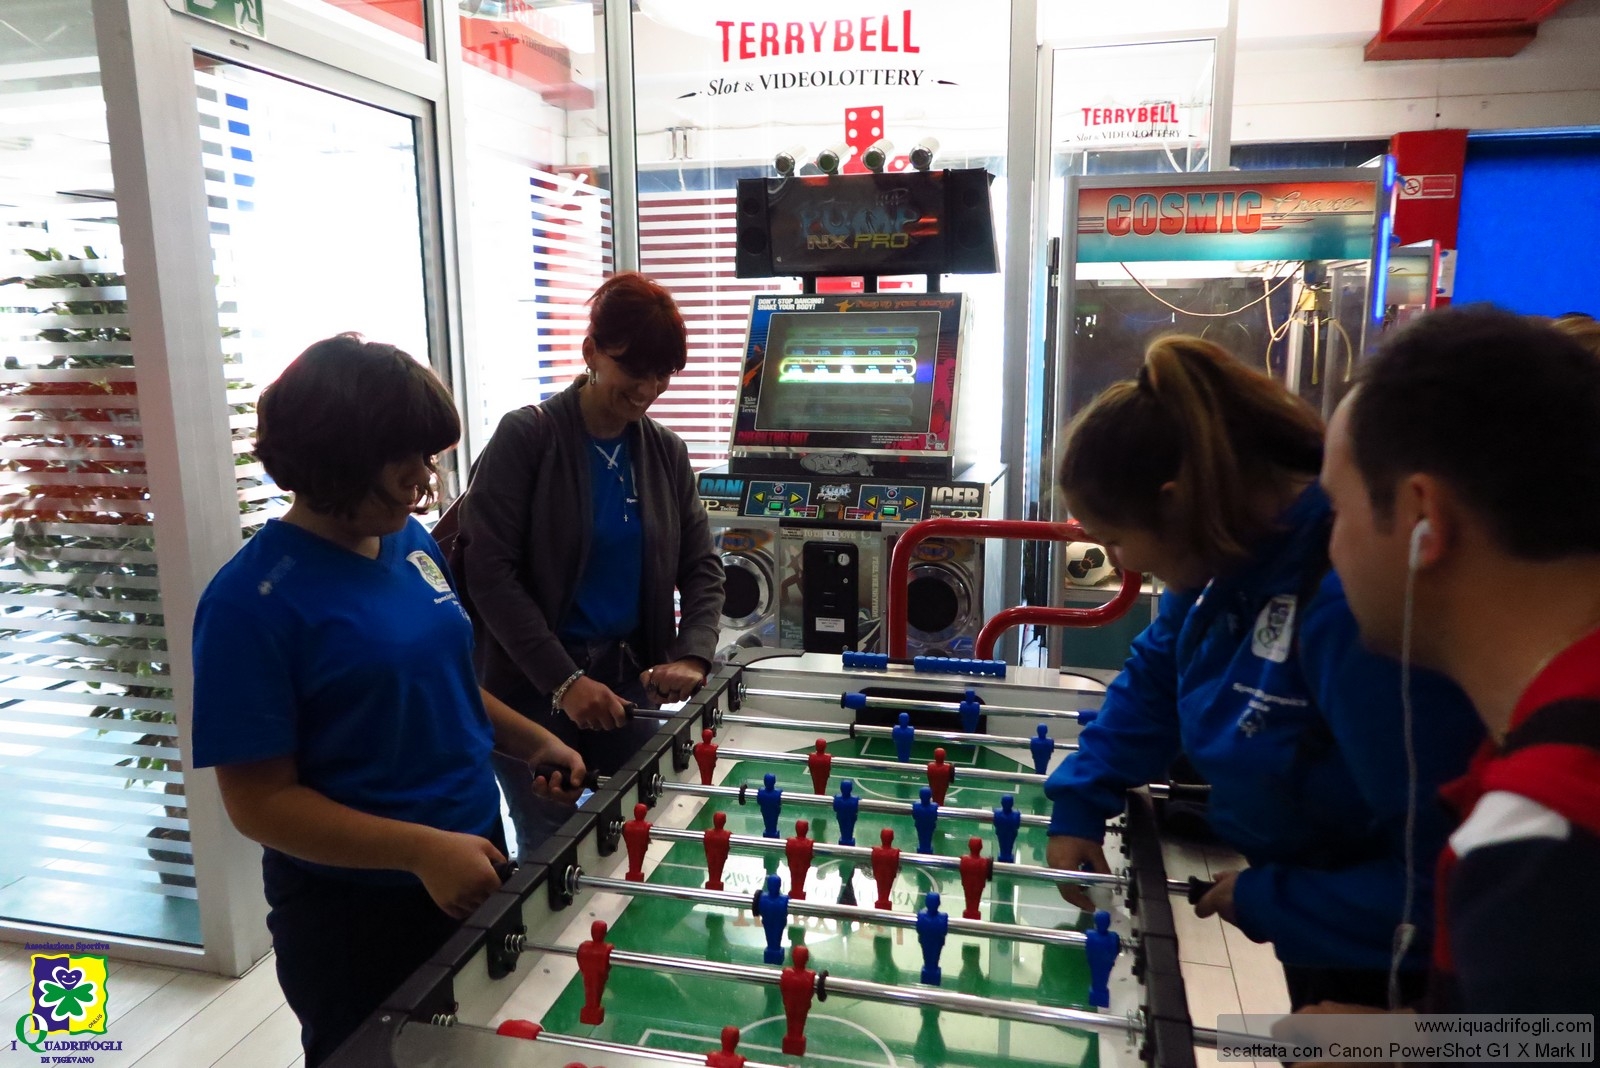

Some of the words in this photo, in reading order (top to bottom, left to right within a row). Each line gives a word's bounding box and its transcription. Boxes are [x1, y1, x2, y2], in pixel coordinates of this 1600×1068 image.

[716, 9, 920, 62] TERRYBELL
[707, 79, 740, 96] Slot
[744, 80, 755, 92] &
[759, 69, 925, 90] VIDEOLOTTERY
[1081, 103, 1179, 126] TERRYBELL
[1106, 190, 1262, 237] COSMIC
[1270, 191, 1364, 220] Crane
[853, 233, 911, 249] PRO
[779, 303, 795, 311] YOUR
